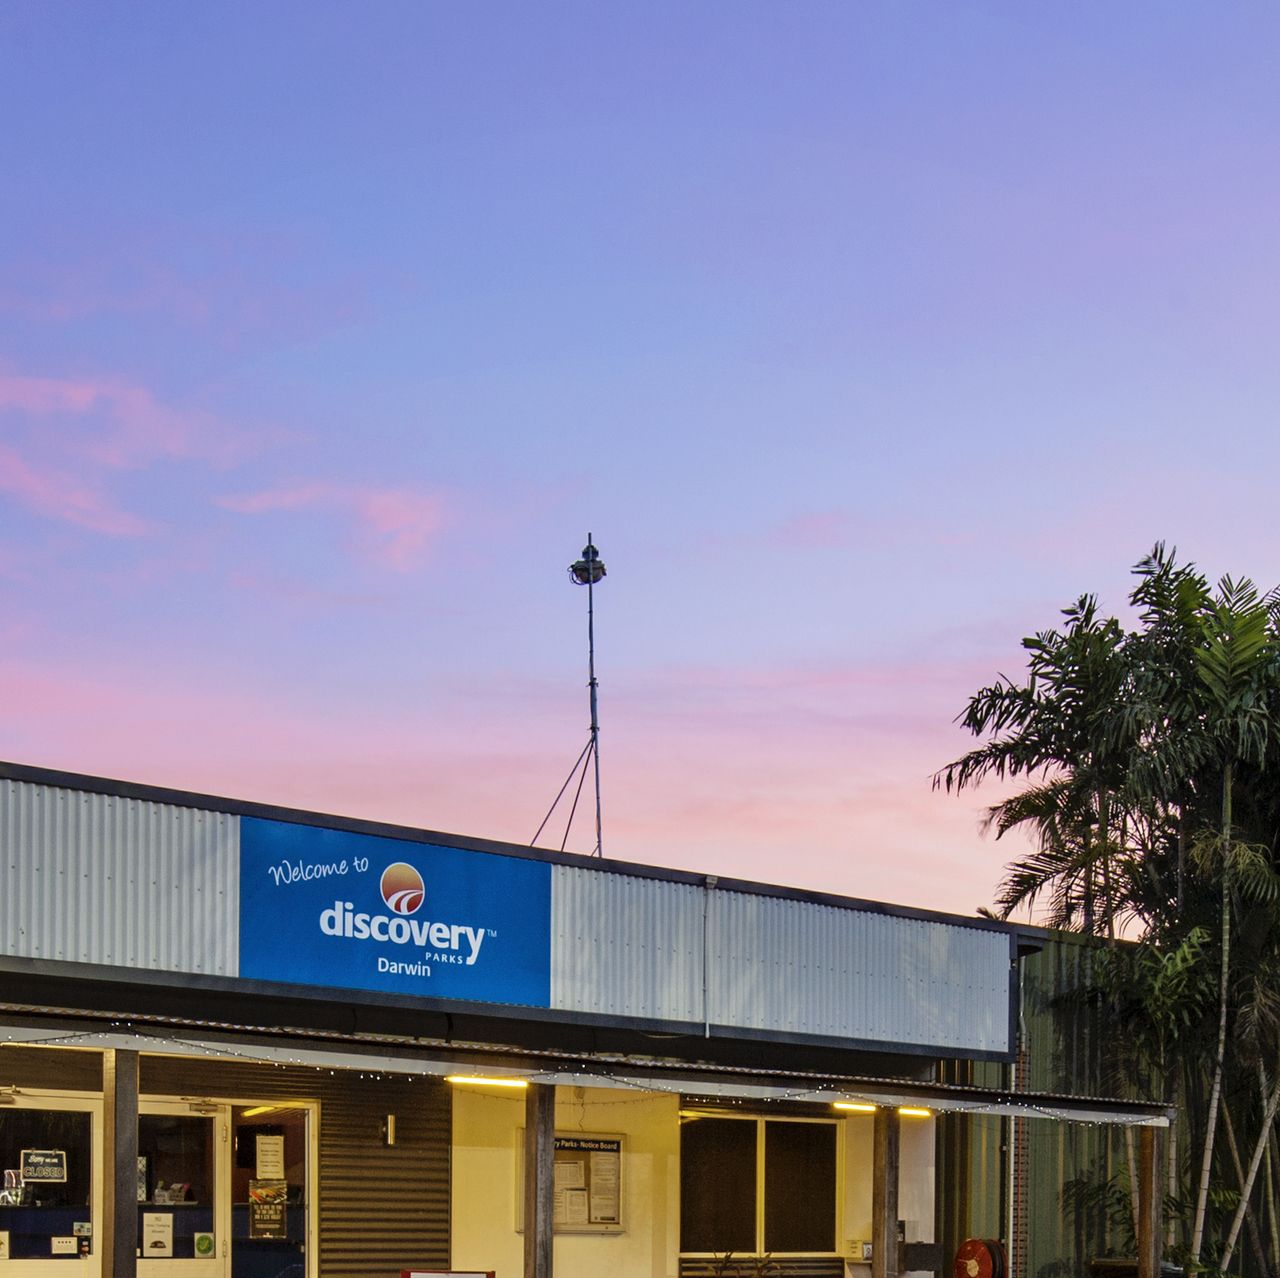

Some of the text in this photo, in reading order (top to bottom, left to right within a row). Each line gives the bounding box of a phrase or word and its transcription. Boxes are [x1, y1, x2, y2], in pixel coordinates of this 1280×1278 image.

[268, 856, 369, 886] Welcome to
[320, 901, 485, 965] discovery
[378, 957, 431, 977] Darwin
[426, 952, 463, 965] PARKS
[24, 1167, 64, 1177] CLOSED
